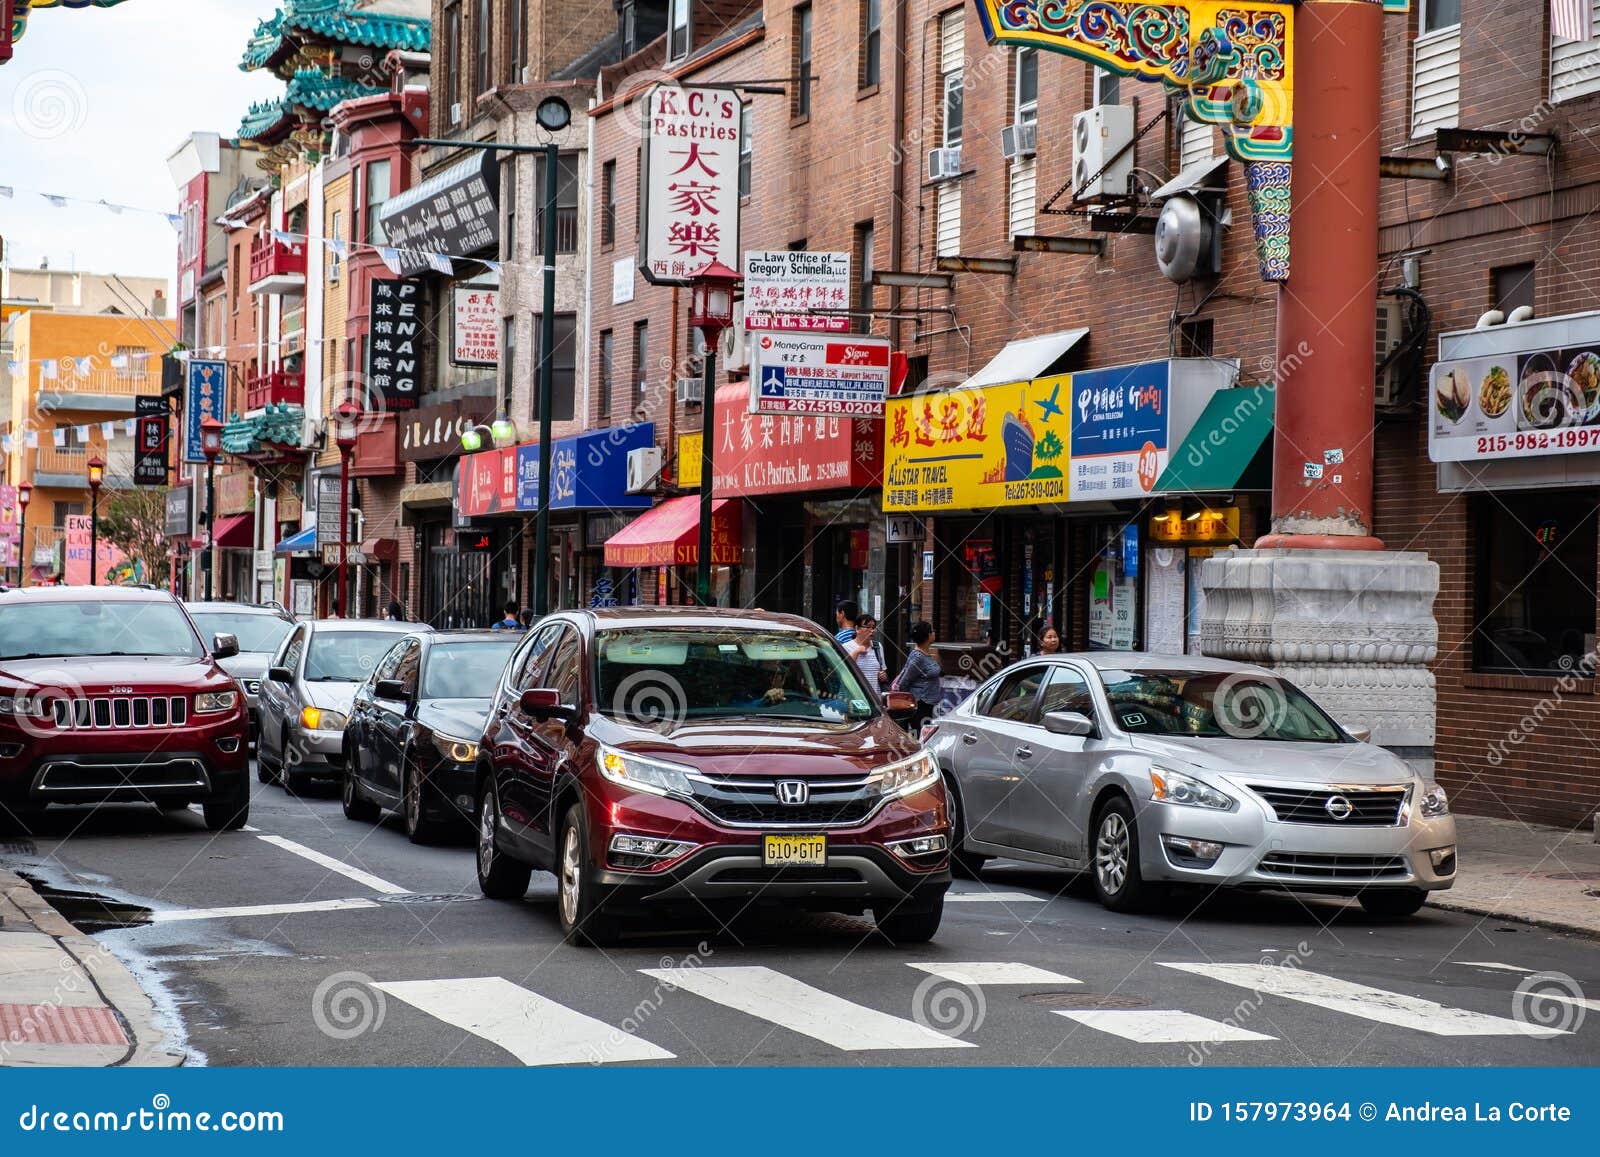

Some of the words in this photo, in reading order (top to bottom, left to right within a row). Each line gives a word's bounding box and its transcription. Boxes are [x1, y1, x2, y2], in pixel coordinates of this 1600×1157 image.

[658, 90, 733, 119] K.C.'s
[655, 118, 737, 140] Pastries
[667, 142, 721, 257] 大家樂
[764, 252, 785, 263] Law
[788, 253, 818, 263] Office
[821, 253, 832, 263] of
[749, 262, 787, 277] Gregory
[791, 263, 835, 277] Schinella,
[396, 285, 415, 391] PENANG
[774, 340, 824, 351] MoneyGram
[788, 400, 883, 414] 267.519.0204
[1477, 429, 1600, 454] 215-982-1997
[888, 463, 920, 486] ALLSTAR
[922, 465, 948, 485] TRAVEL
[891, 520, 925, 537] ATM
[109, 684, 134, 694] Jeep
